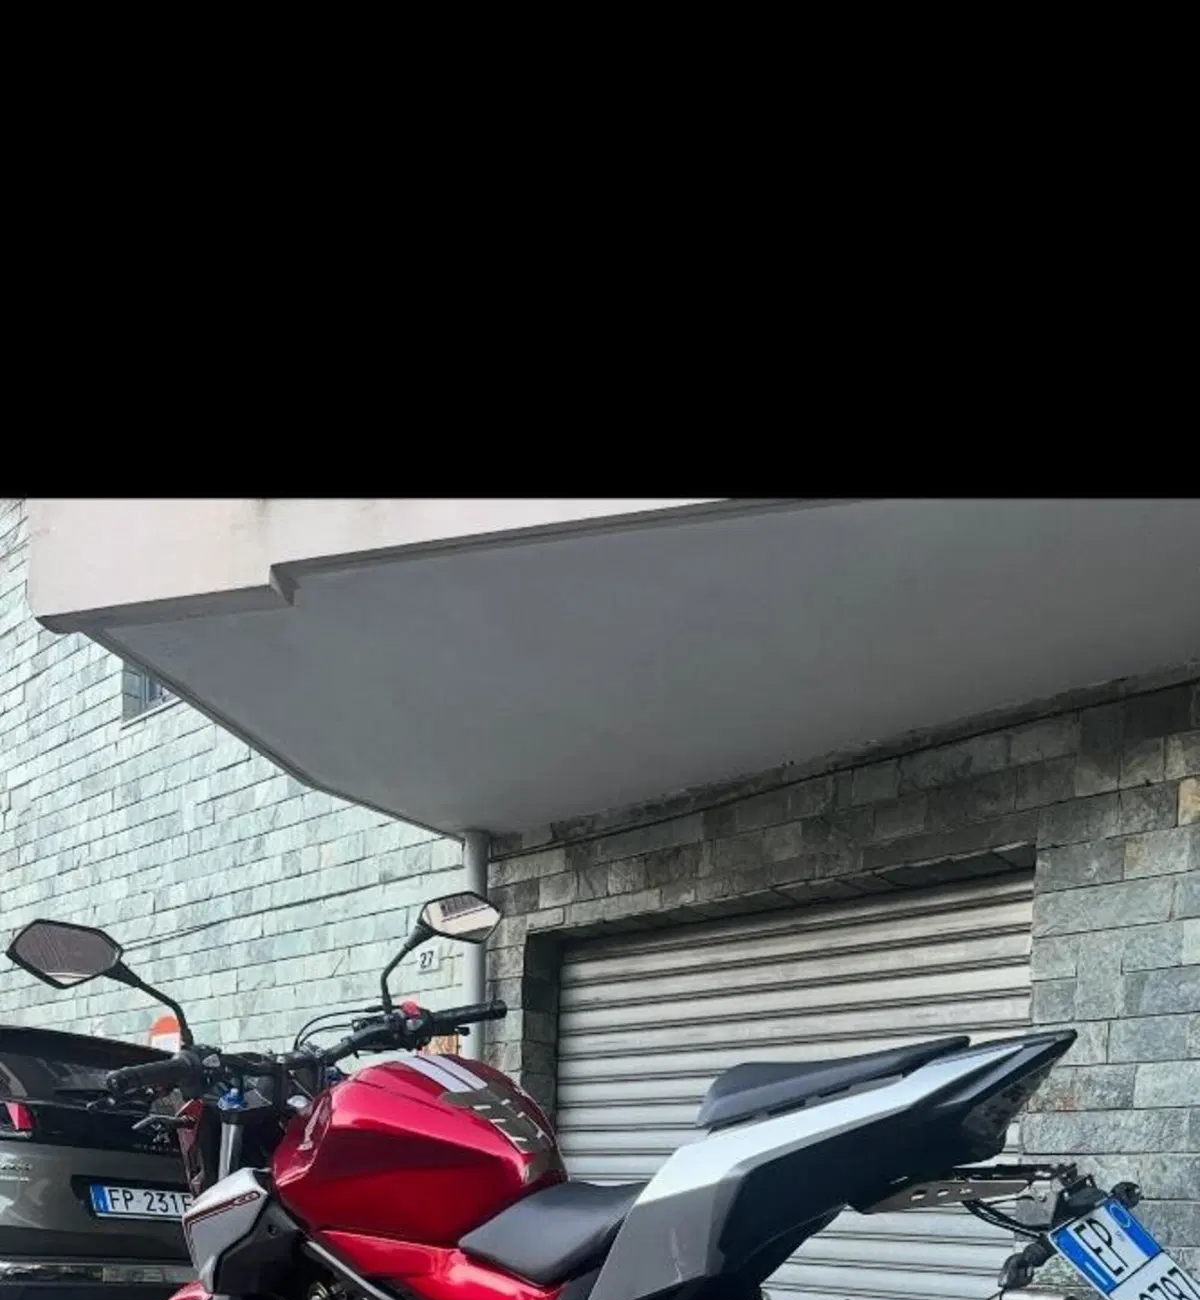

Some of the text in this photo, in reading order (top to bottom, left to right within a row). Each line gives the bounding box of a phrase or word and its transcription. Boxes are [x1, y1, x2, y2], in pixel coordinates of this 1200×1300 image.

[420, 950, 434, 969] 27
[107, 1188, 134, 1211] FP
[1073, 1218, 1129, 1277] EP
